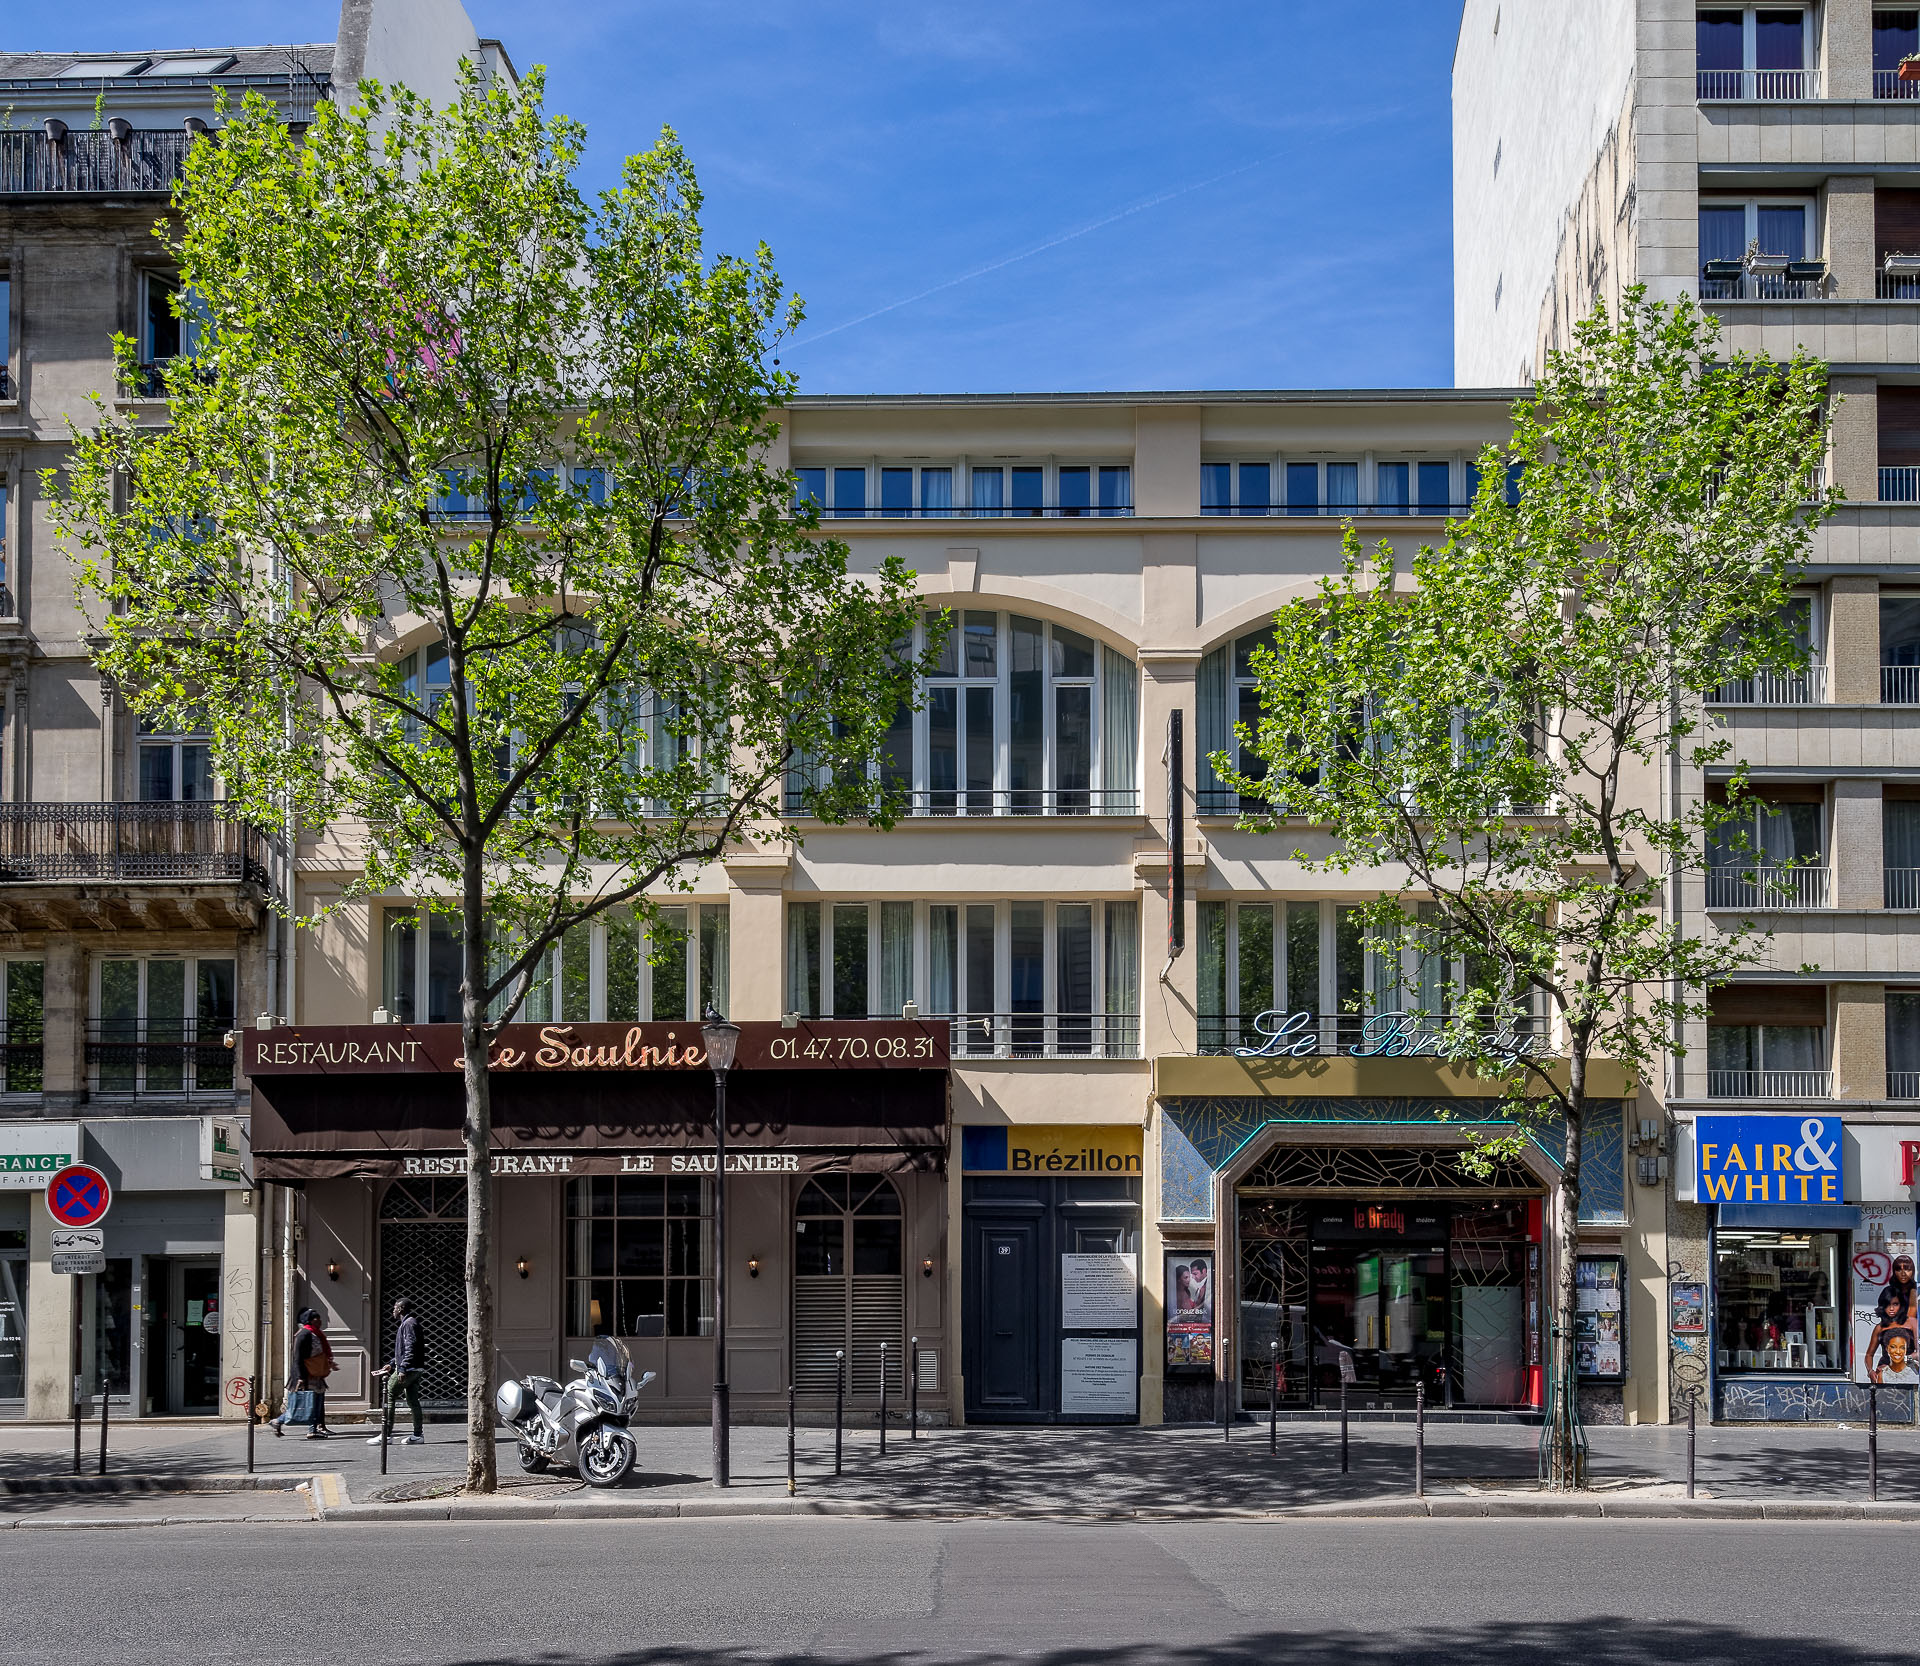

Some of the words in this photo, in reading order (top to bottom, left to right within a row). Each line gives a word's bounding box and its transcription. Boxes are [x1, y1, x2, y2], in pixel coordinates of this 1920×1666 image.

[1235, 1010, 1317, 1056] Le
[257, 1042, 422, 1064] RESTAURANT
[453, 1036, 526, 1068] e
[403, 1156, 573, 1175] RESTURANT
[621, 1155, 654, 1171] LE
[671, 1154, 800, 1172] SAULNIER
[1012, 1148, 1140, 1171] Brézillon
[1703, 1175, 1836, 1201] WHITE
[1354, 1208, 1365, 1228] le
[1369, 1207, 1405, 1234] Brady
